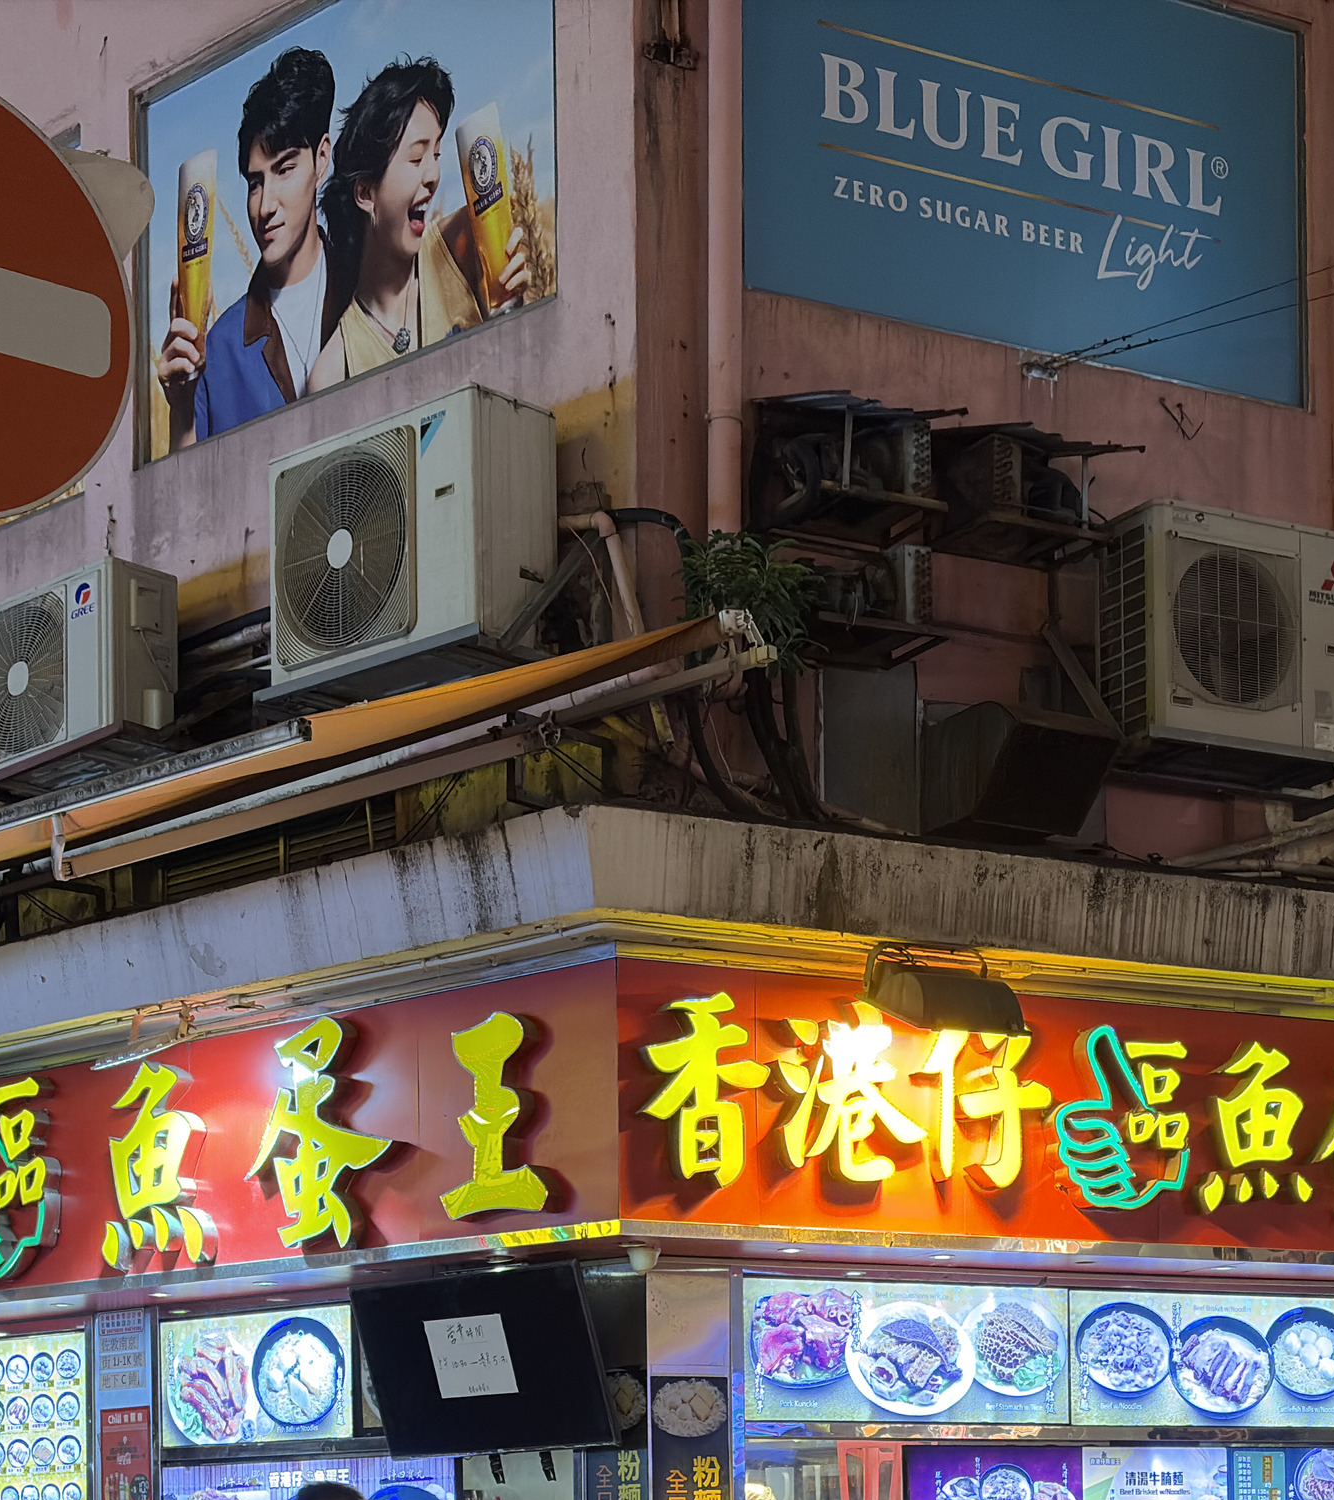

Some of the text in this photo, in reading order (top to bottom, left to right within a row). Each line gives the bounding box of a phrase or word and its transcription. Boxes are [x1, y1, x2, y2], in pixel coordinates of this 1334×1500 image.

[819, 53, 1023, 167] BLUE
[833, 175, 1212, 291] ZERO SUGAR BEER Light
[71, 602, 96, 620] GREE
[1119, 1487, 1158, 1497] Beef Brisket
